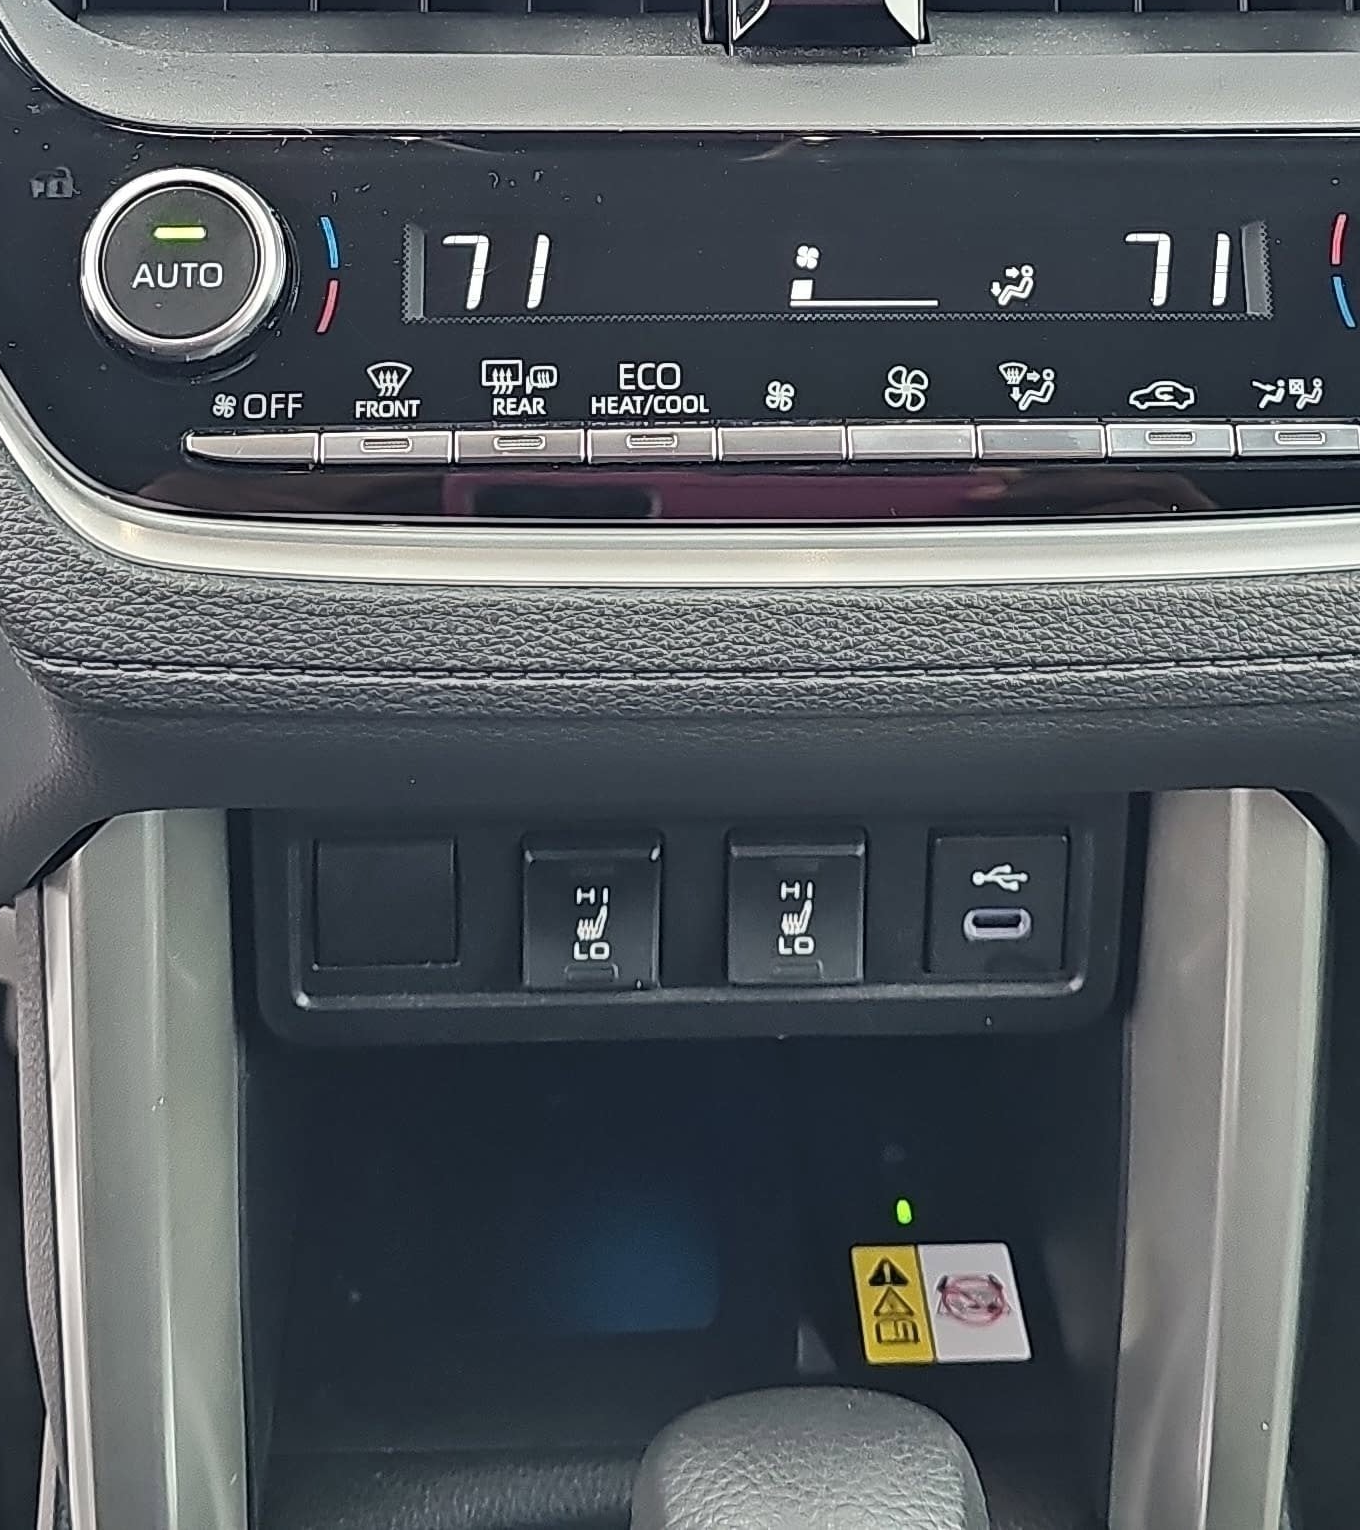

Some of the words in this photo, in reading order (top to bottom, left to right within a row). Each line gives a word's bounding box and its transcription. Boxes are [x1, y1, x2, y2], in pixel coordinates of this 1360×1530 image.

[132, 262, 224, 288] AUTO
[442, 234, 550, 311] 71
[1124, 233, 1231, 308] 71
[618, 363, 682, 391] ECO
[243, 393, 303, 419] OFF
[355, 399, 420, 419] FRONT
[492, 396, 547, 417] REAR
[590, 395, 710, 416] HEAT/COOL
[575, 886, 609, 905] HI
[780, 881, 814, 900] HI
[573, 941, 610, 960] LO
[777, 935, 815, 956] LO
